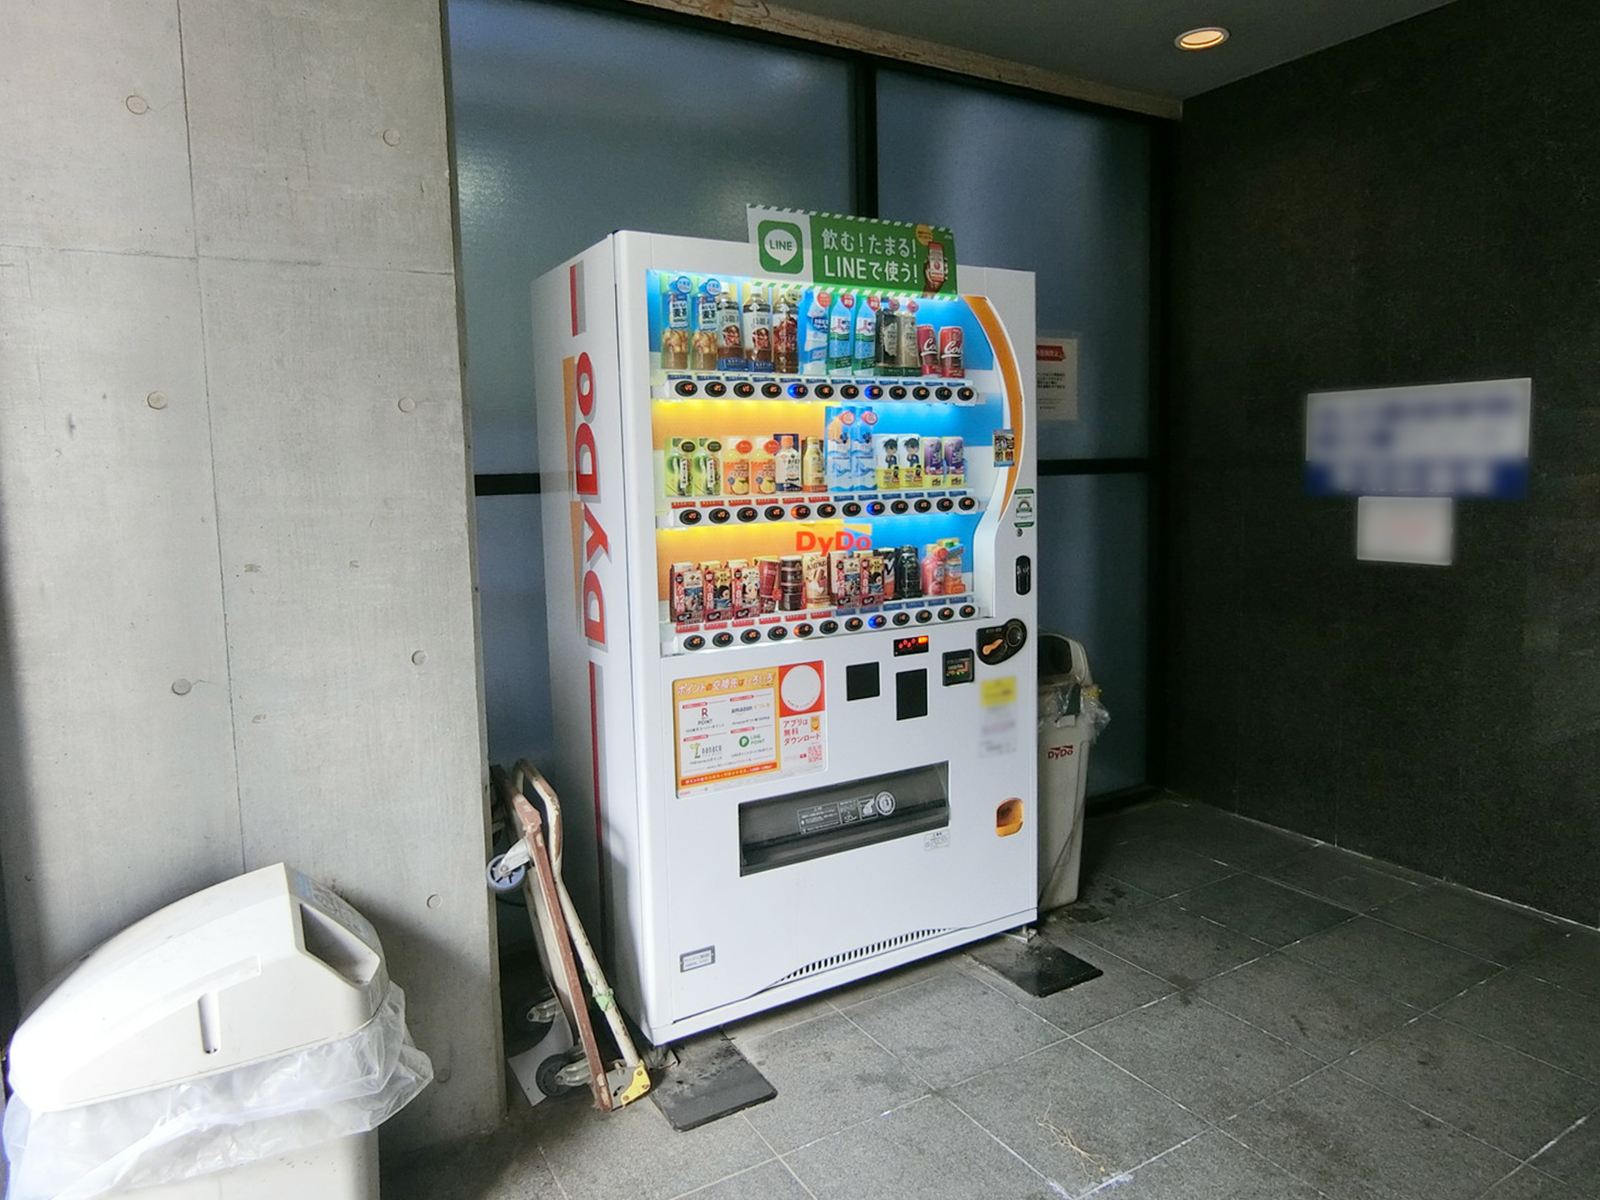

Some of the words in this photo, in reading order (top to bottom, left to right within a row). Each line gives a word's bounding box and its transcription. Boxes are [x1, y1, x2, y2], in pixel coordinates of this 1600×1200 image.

[769, 239, 793, 251] LINE
[923, 338, 938, 351] Co
[944, 340, 963, 354] Col
[796, 531, 872, 556] DyDo
[731, 705, 753, 714] amazon
[1047, 748, 1073, 760] DyDo
